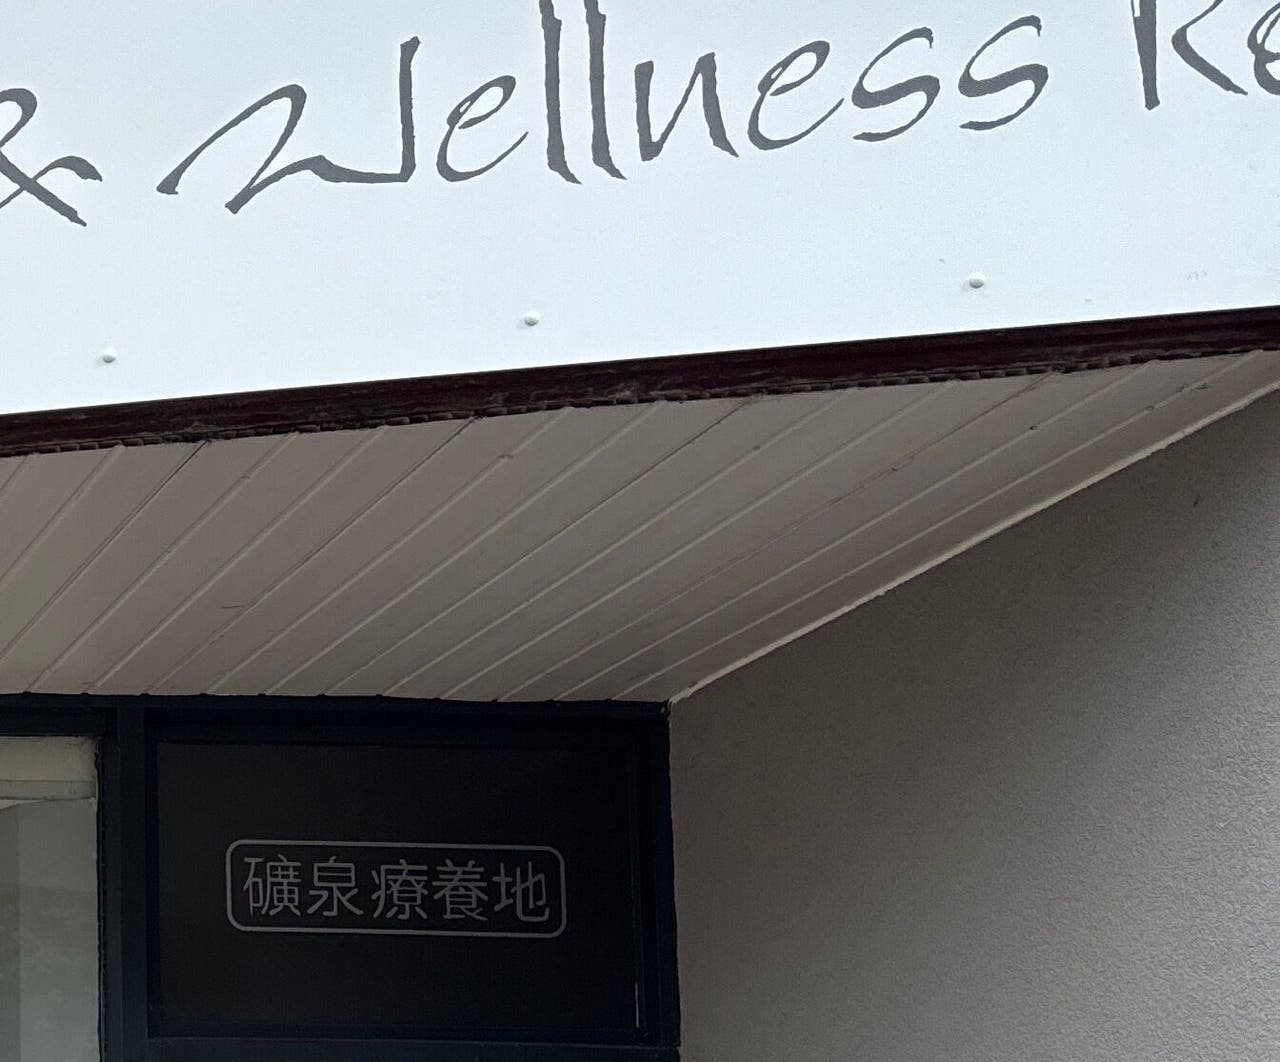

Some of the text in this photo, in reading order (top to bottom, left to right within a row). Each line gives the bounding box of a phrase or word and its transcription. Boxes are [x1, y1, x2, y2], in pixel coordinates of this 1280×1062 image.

[156, 0, 1048, 216] Wellness
[243, 853, 551, 923] 礦泉療養地
